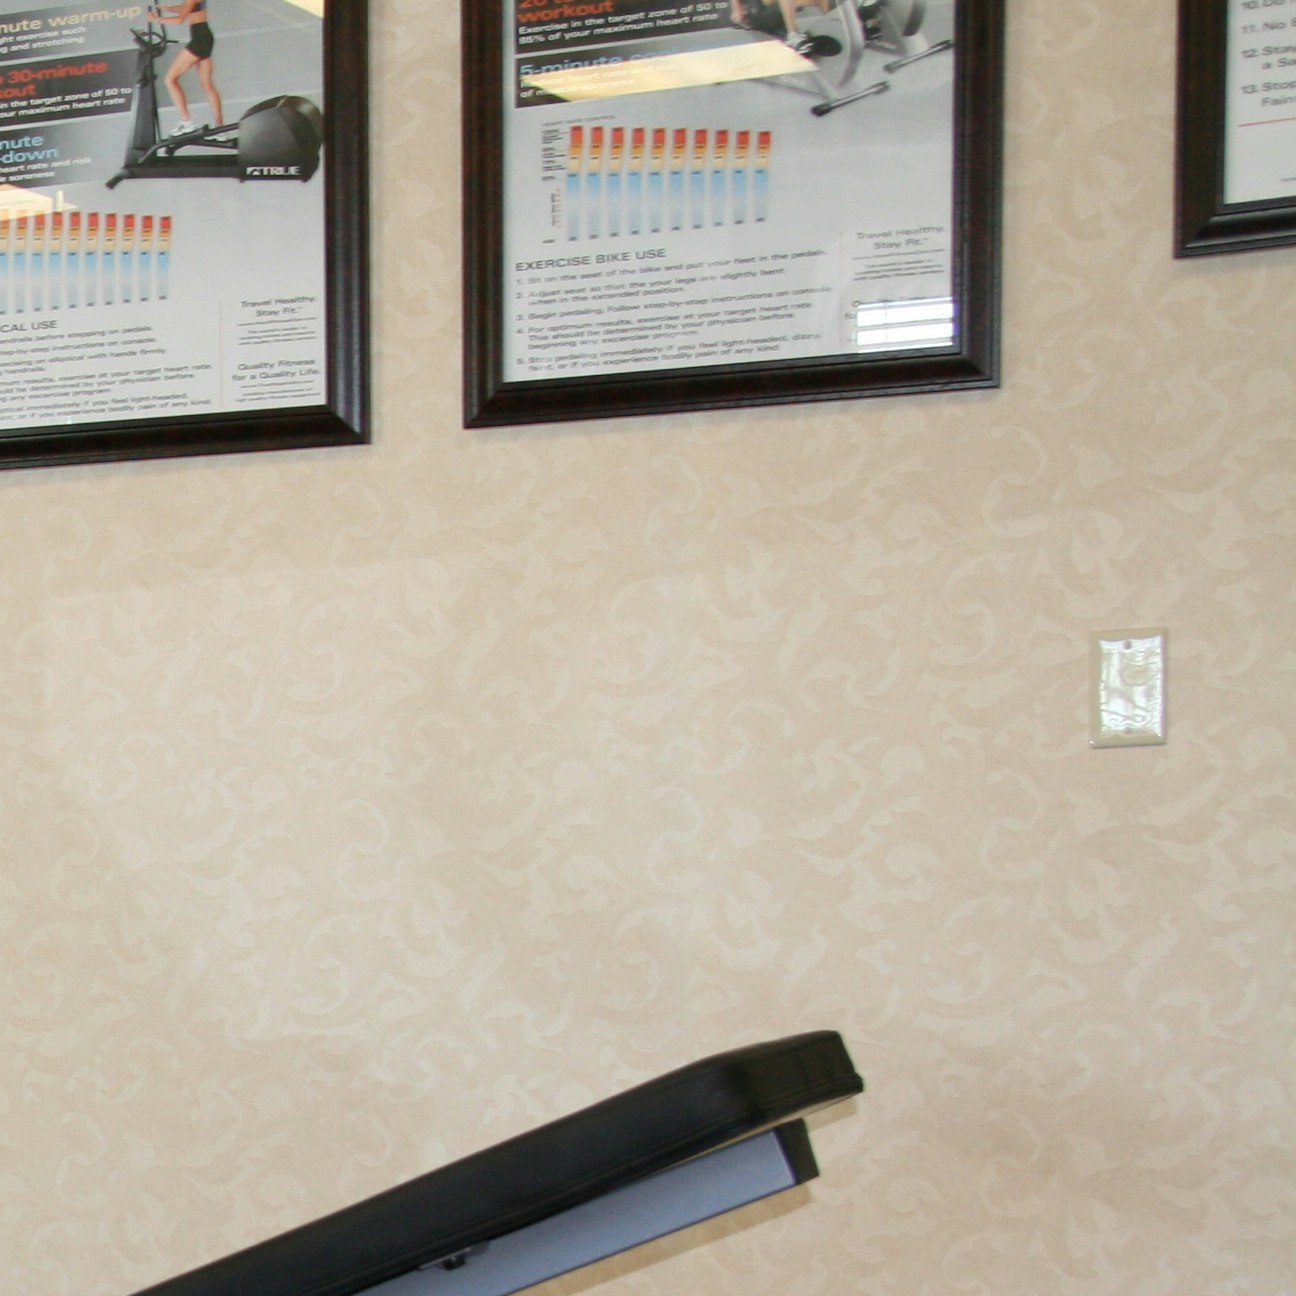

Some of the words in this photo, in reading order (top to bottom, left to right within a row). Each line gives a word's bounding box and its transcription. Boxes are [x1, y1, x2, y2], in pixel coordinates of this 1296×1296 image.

[48, 7, 140, 26] warm-up
[518, 1, 612, 22] workout
[9, 63, 107, 83] 30-minute
[262, 166, 301, 177] TRUE
[516, 256, 590, 271] EXERCISE
[596, 252, 630, 264] BIKE
[635, 248, 666, 260] USE
[31, 320, 57, 330] USE
